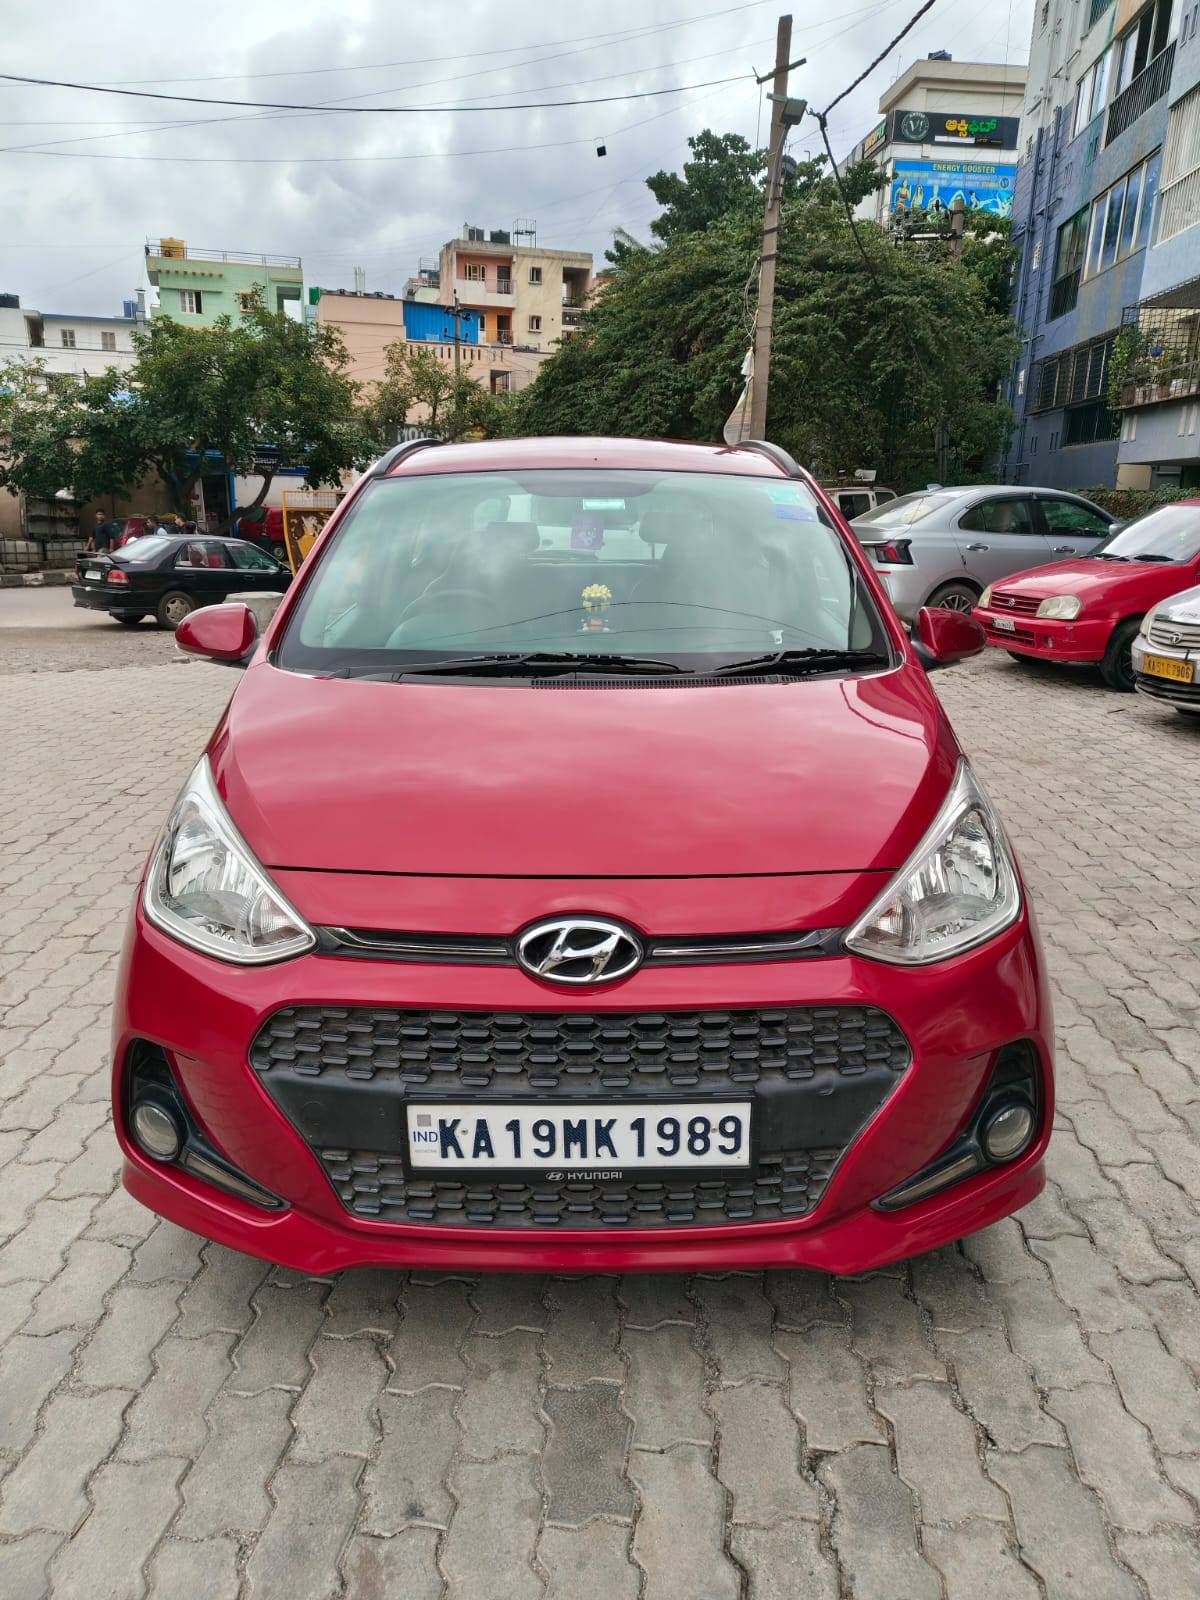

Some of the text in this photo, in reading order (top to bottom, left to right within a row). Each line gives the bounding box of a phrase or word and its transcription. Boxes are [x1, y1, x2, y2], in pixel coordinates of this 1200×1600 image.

[933, 163, 996, 174] ENERGY BOOSTER
[413, 1115, 743, 1159] IND KA19MK1989
[567, 1171, 623, 1180] HYUNDAI
